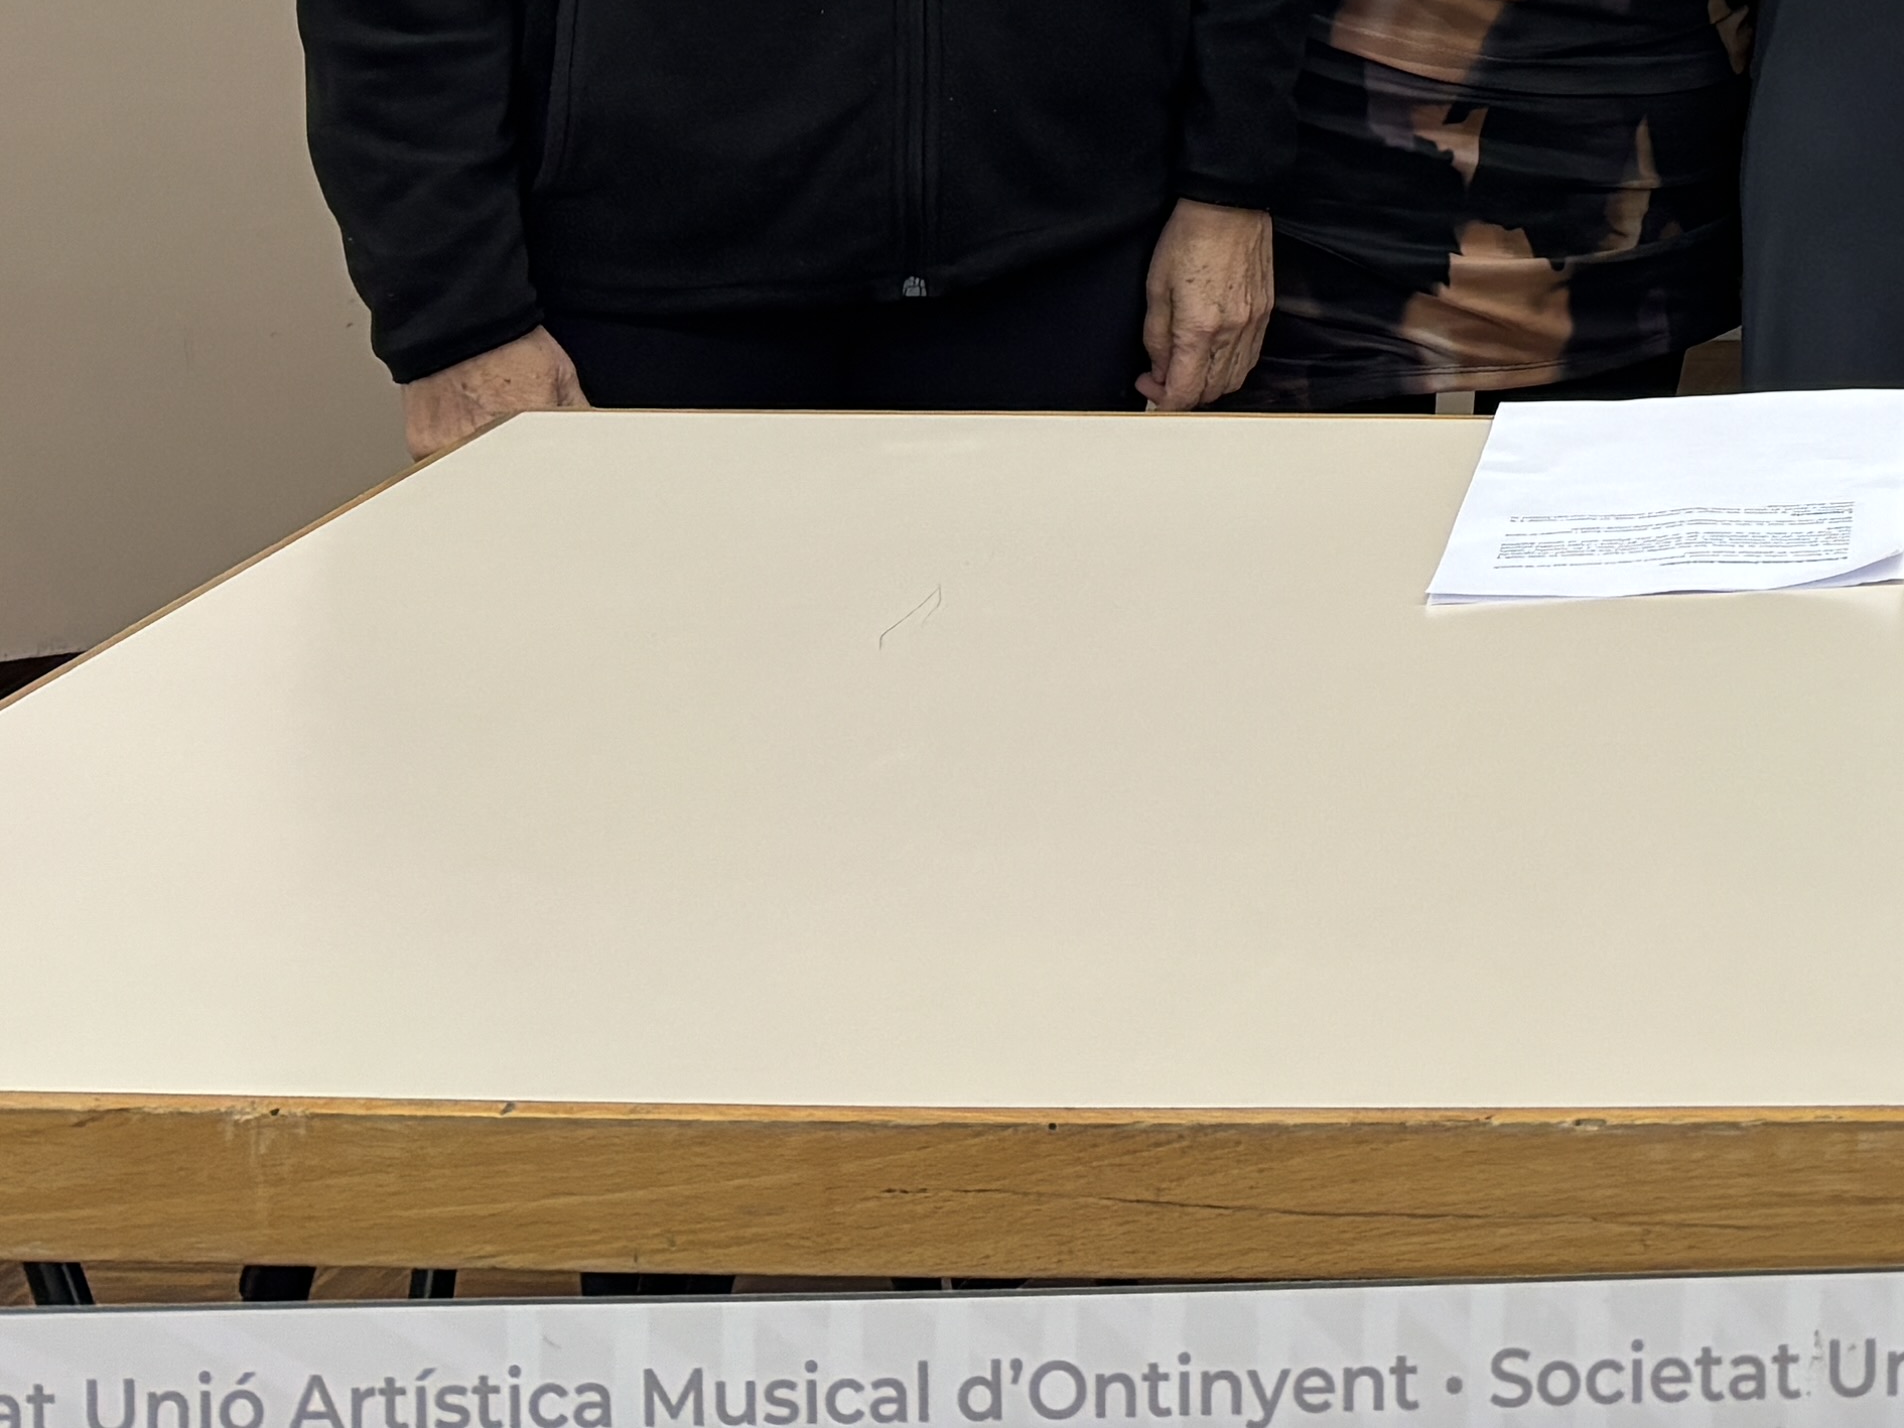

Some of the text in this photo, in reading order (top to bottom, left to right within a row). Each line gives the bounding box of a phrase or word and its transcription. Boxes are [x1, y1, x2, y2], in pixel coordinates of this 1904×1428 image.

[86, 1370, 265, 1428] Unió
[289, 1364, 613, 1428] Artística
[643, 1359, 930, 1428] Musical
[1490, 1338, 1802, 1409] Societat
